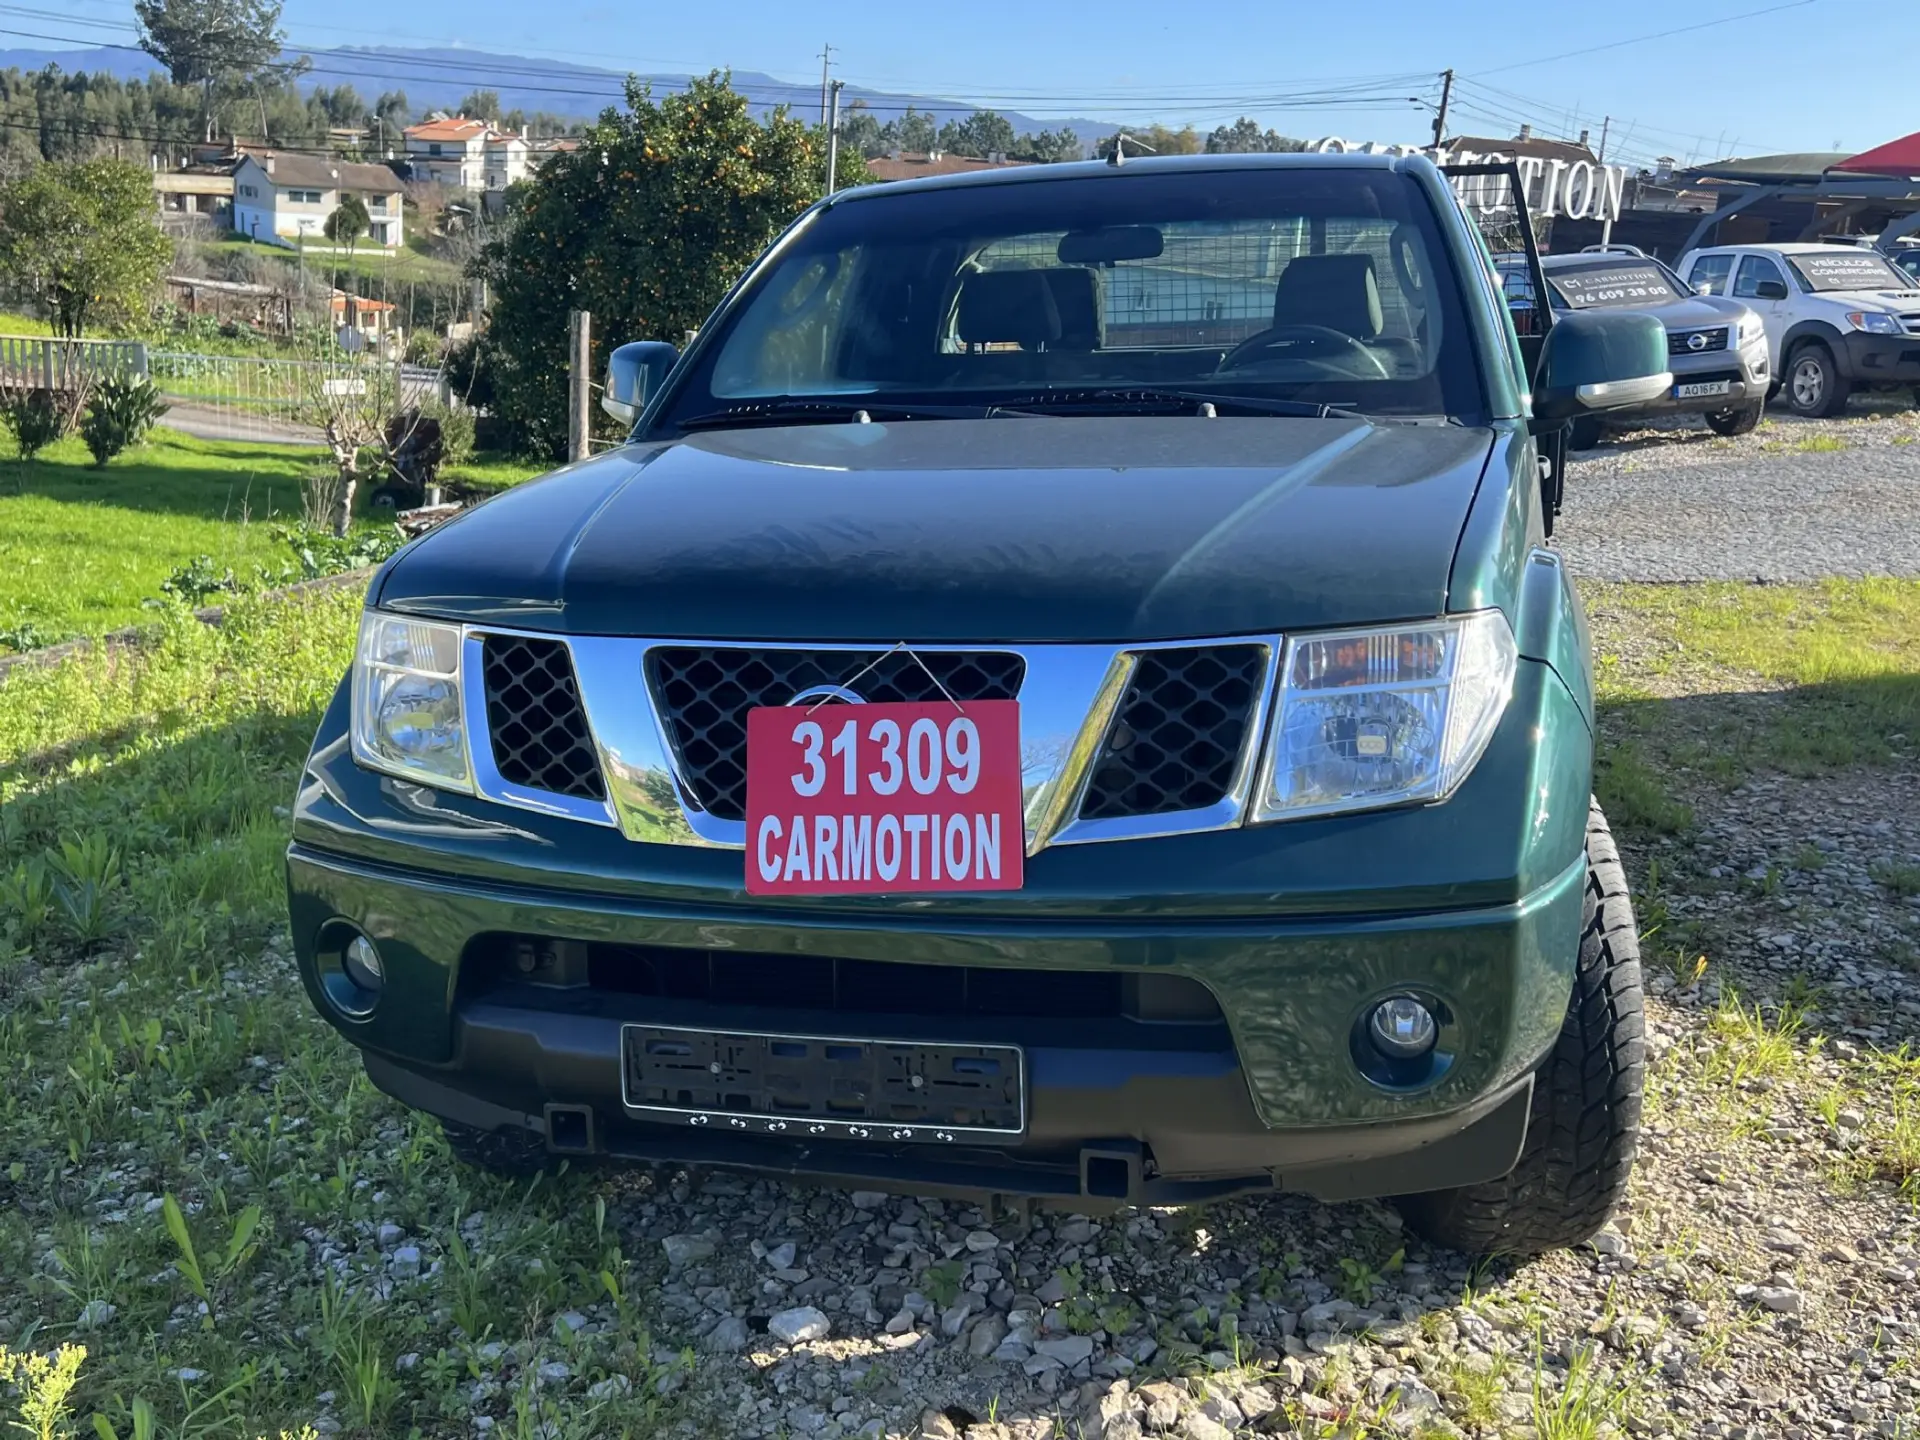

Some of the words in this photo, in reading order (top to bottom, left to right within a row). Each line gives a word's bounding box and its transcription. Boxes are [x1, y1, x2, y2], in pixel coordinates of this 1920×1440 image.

[1575, 293, 1596, 303] 96
[1598, 289, 1625, 300] 609
[1648, 286, 1668, 295] 00
[1585, 272, 1656, 284] CARMOTION
[791, 717, 981, 797] 31309
[757, 813, 1000, 882] CARMOTION
